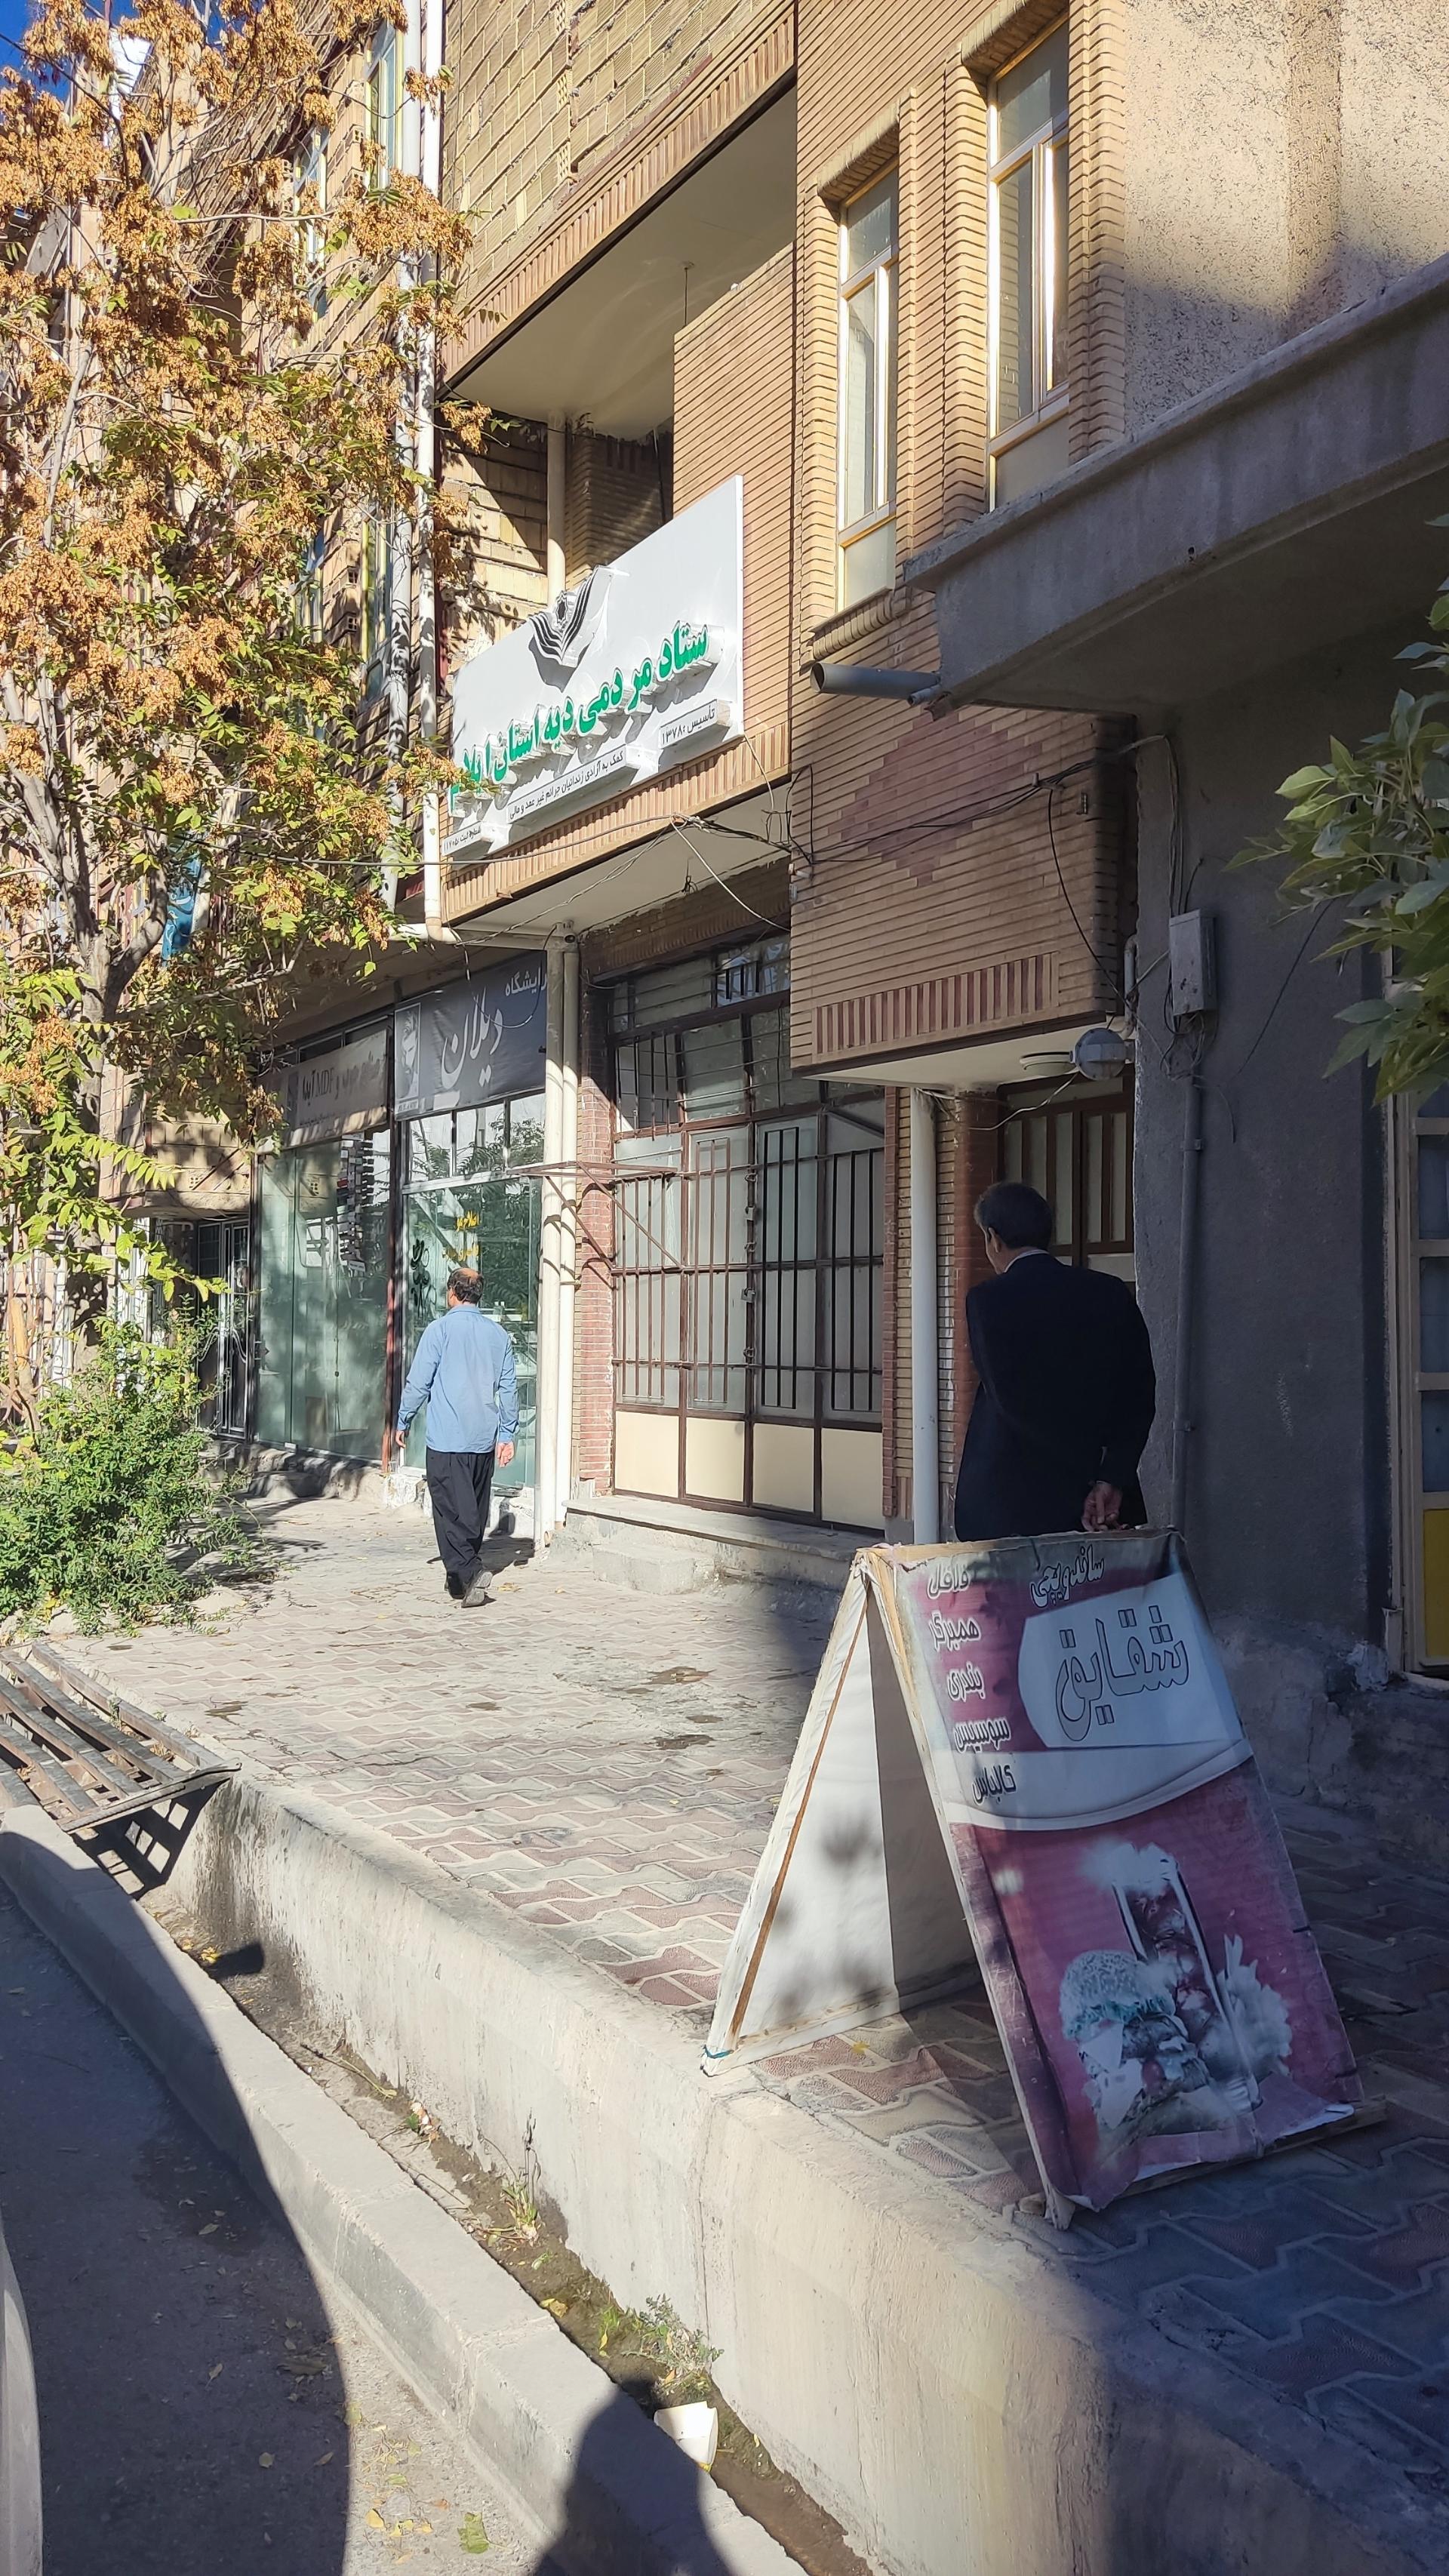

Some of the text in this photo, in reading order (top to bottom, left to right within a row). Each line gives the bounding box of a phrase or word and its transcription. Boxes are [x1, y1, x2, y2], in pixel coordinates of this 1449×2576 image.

[658, 622, 708, 680] ستاد
[544, 697, 574, 748] دیه
[688, 704, 715, 734] تأسیس
[493, 706, 540, 782] استان
[610, 750, 624, 766] کمک
[561, 771, 584, 793] زندانیان
[585, 760, 601, 781] آزادی
[525, 799, 535, 810] عمد
[535, 791, 545, 807] غیر
[545, 785, 561, 802] جرائم
[509, 805, 521, 820] مالی
[505, 967, 547, 996] رایشگاه
[928, 1563, 971, 1599] فلافل
[1030, 1543, 1105, 1609] ساندویچی
[928, 1611, 981, 1651] همبرگر
[948, 1661, 986, 1702] بندری
[1055, 1605, 1190, 1742] شقایق
[954, 1716, 1011, 1753] سوسیس
[971, 1763, 1017, 1805] کالباس
